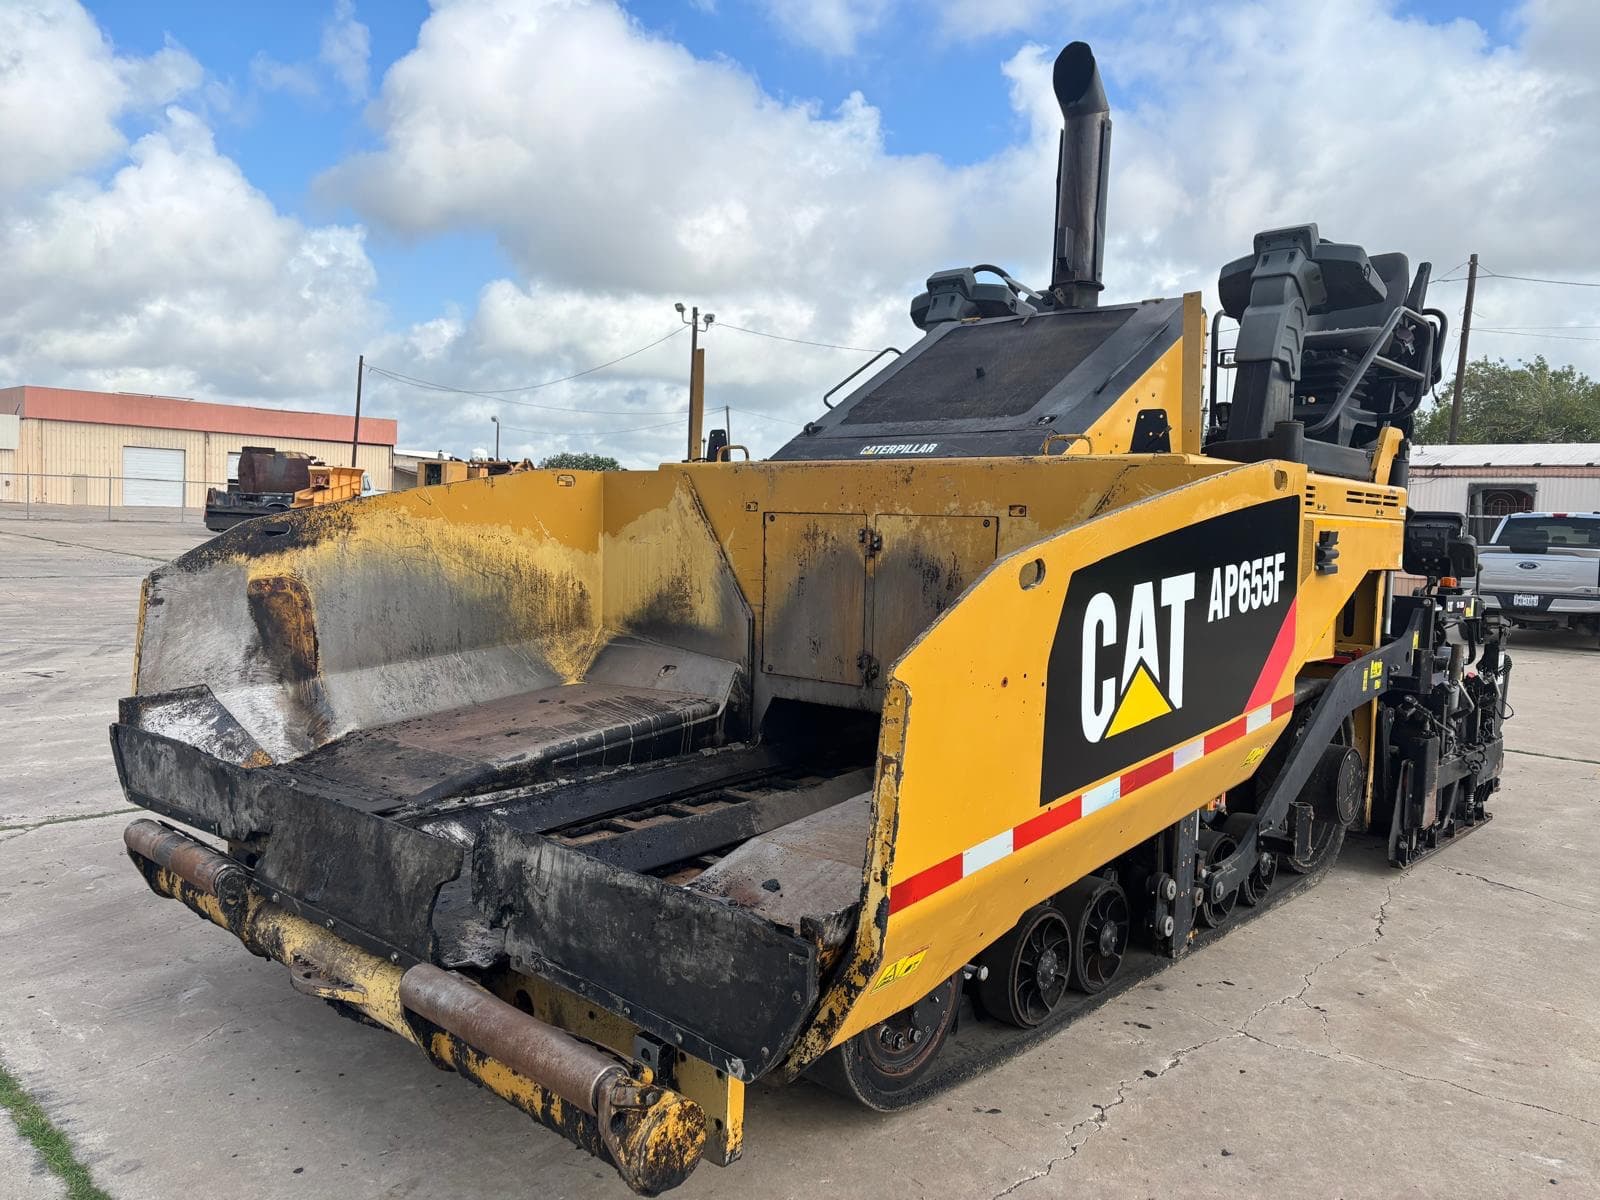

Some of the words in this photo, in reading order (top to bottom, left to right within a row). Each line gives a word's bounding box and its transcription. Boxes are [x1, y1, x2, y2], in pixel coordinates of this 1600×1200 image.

[860, 443, 938, 455] CATERPILLAR
[1207, 552, 1285, 623] AP655F
[1081, 572, 1195, 743] CAT
